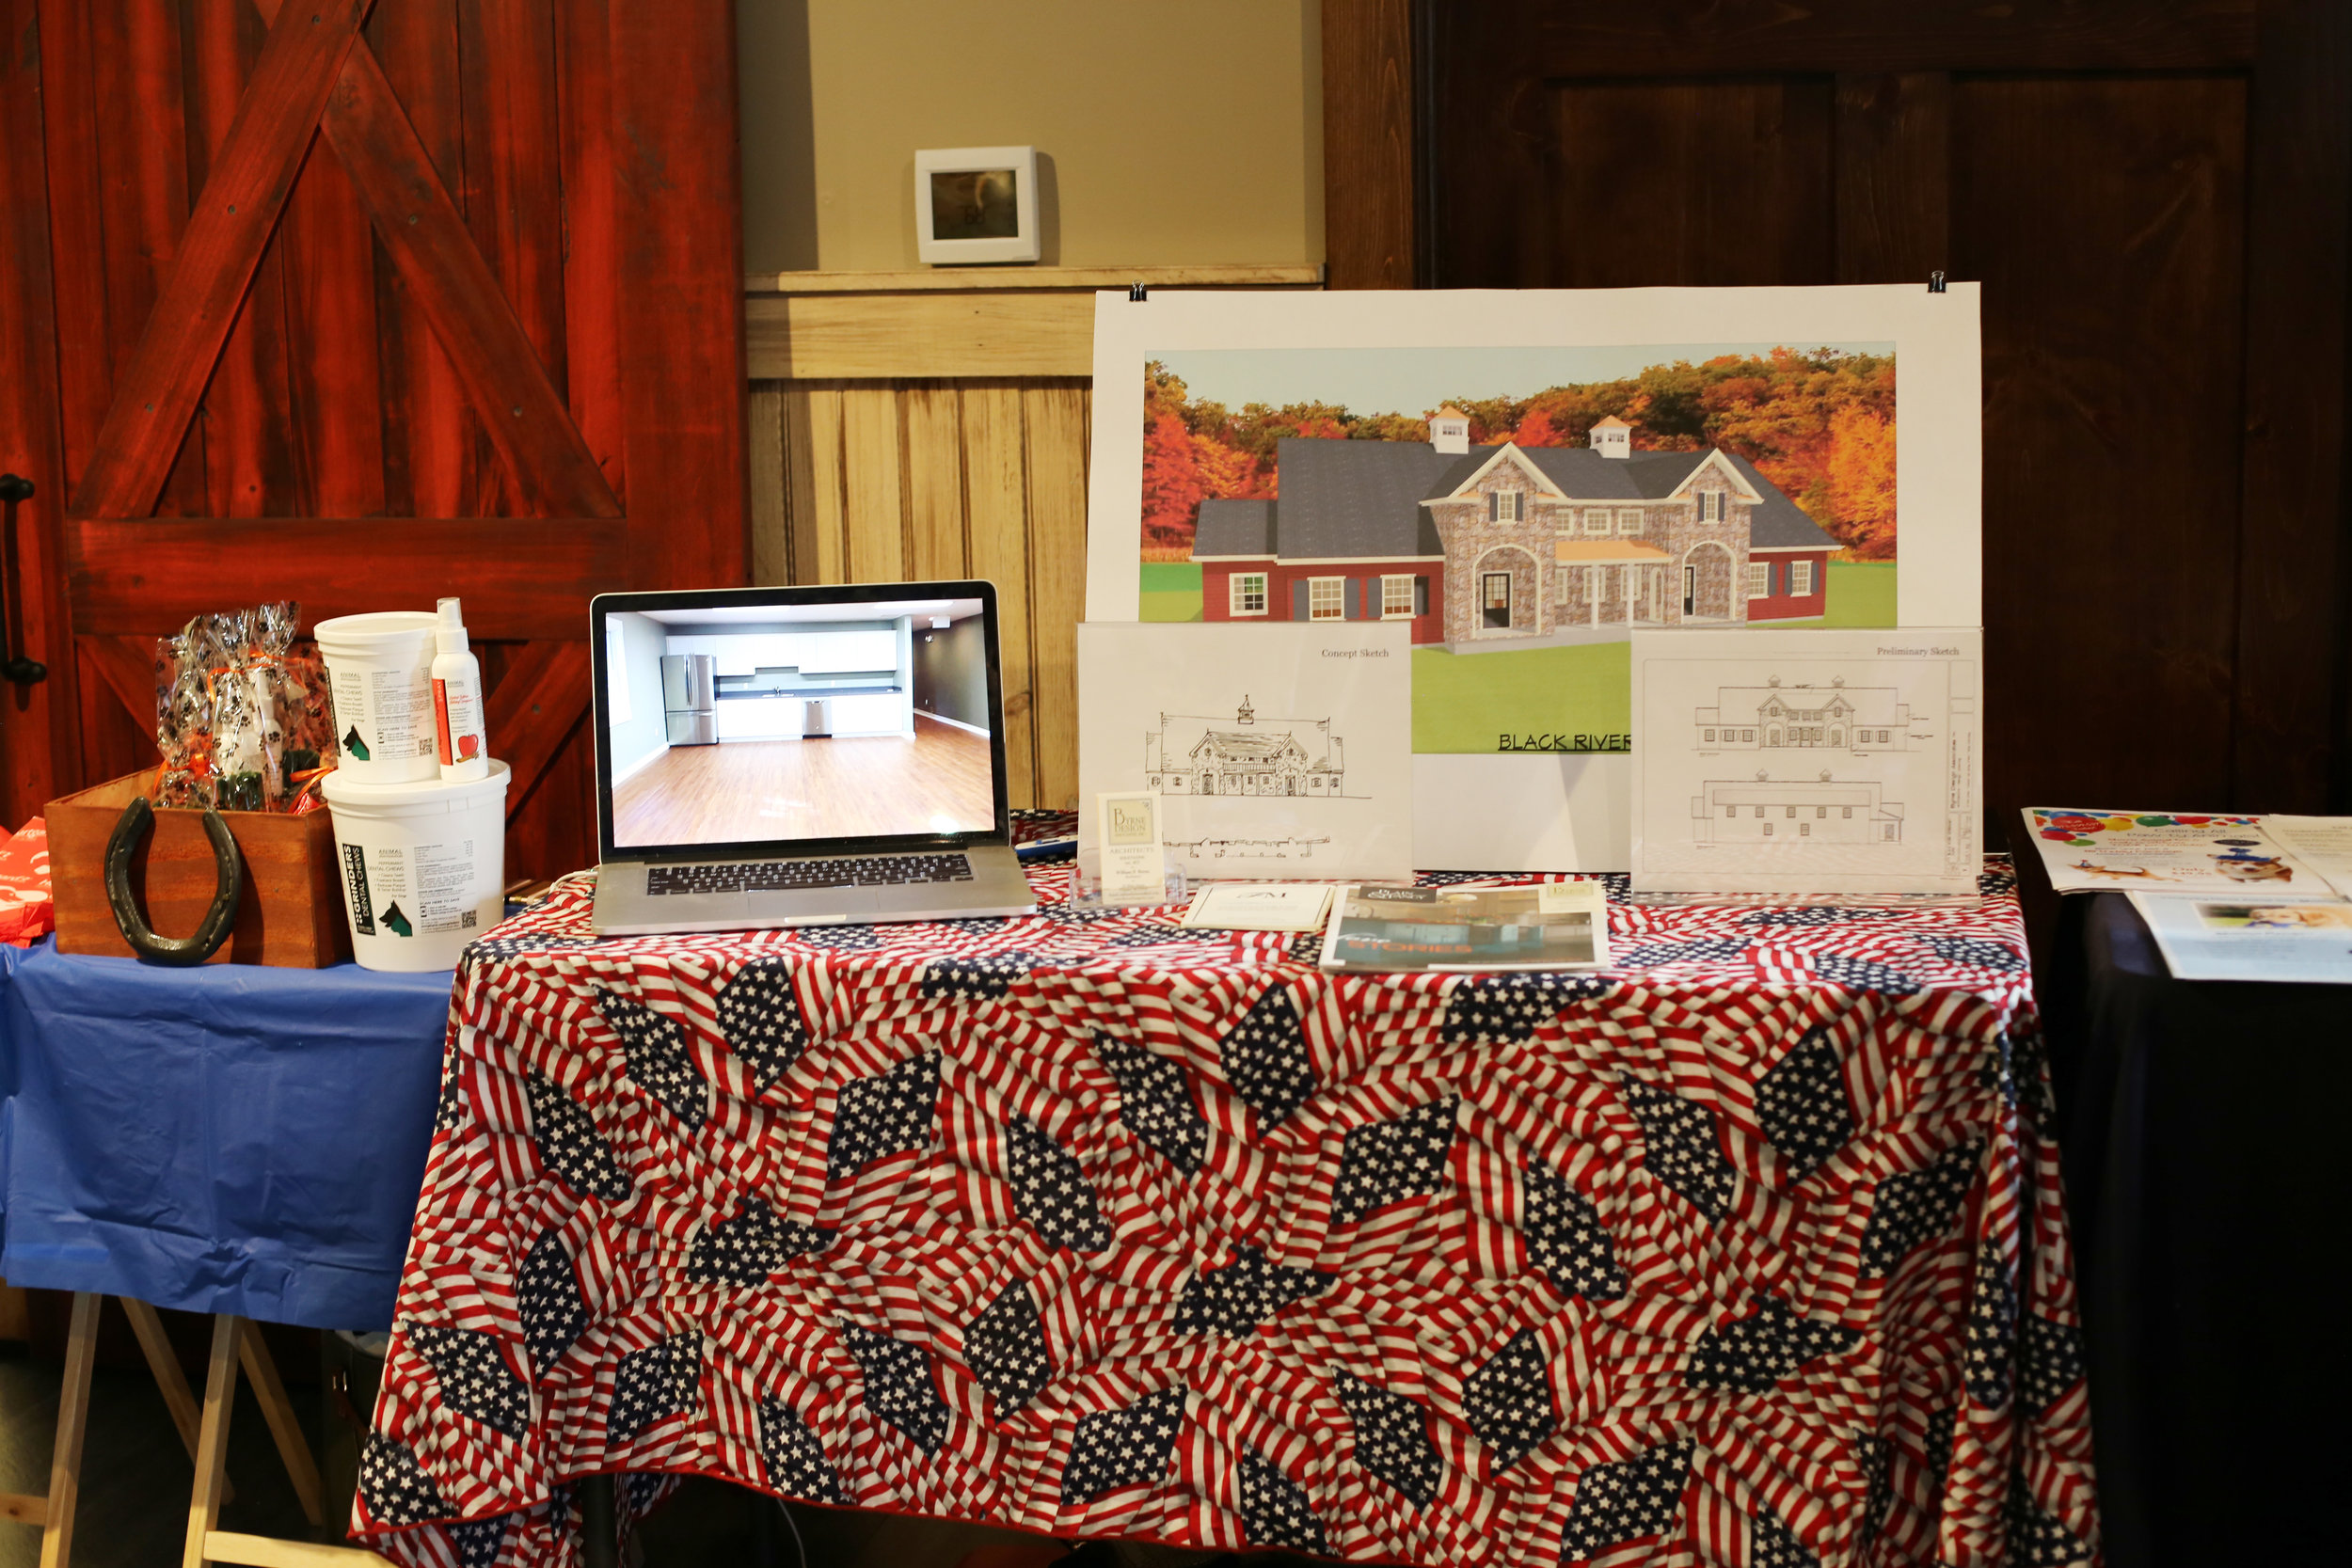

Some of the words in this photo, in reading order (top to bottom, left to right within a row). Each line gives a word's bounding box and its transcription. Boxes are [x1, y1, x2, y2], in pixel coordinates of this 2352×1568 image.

[1322, 648, 1357, 659] Concept
[1360, 647, 1389, 657] Sketch
[1877, 646, 1929, 657] Preliminary
[1930, 646, 1960, 656] Sketch
[1499, 734, 1567, 751] BLACK
[1114, 808, 1146, 825] BYRNE
[352, 847, 363, 880] CHEWS
[343, 845, 361, 913] GRINDERS
[358, 880, 370, 917] DENTAL
[1347, 940, 1473, 953] STORIES
